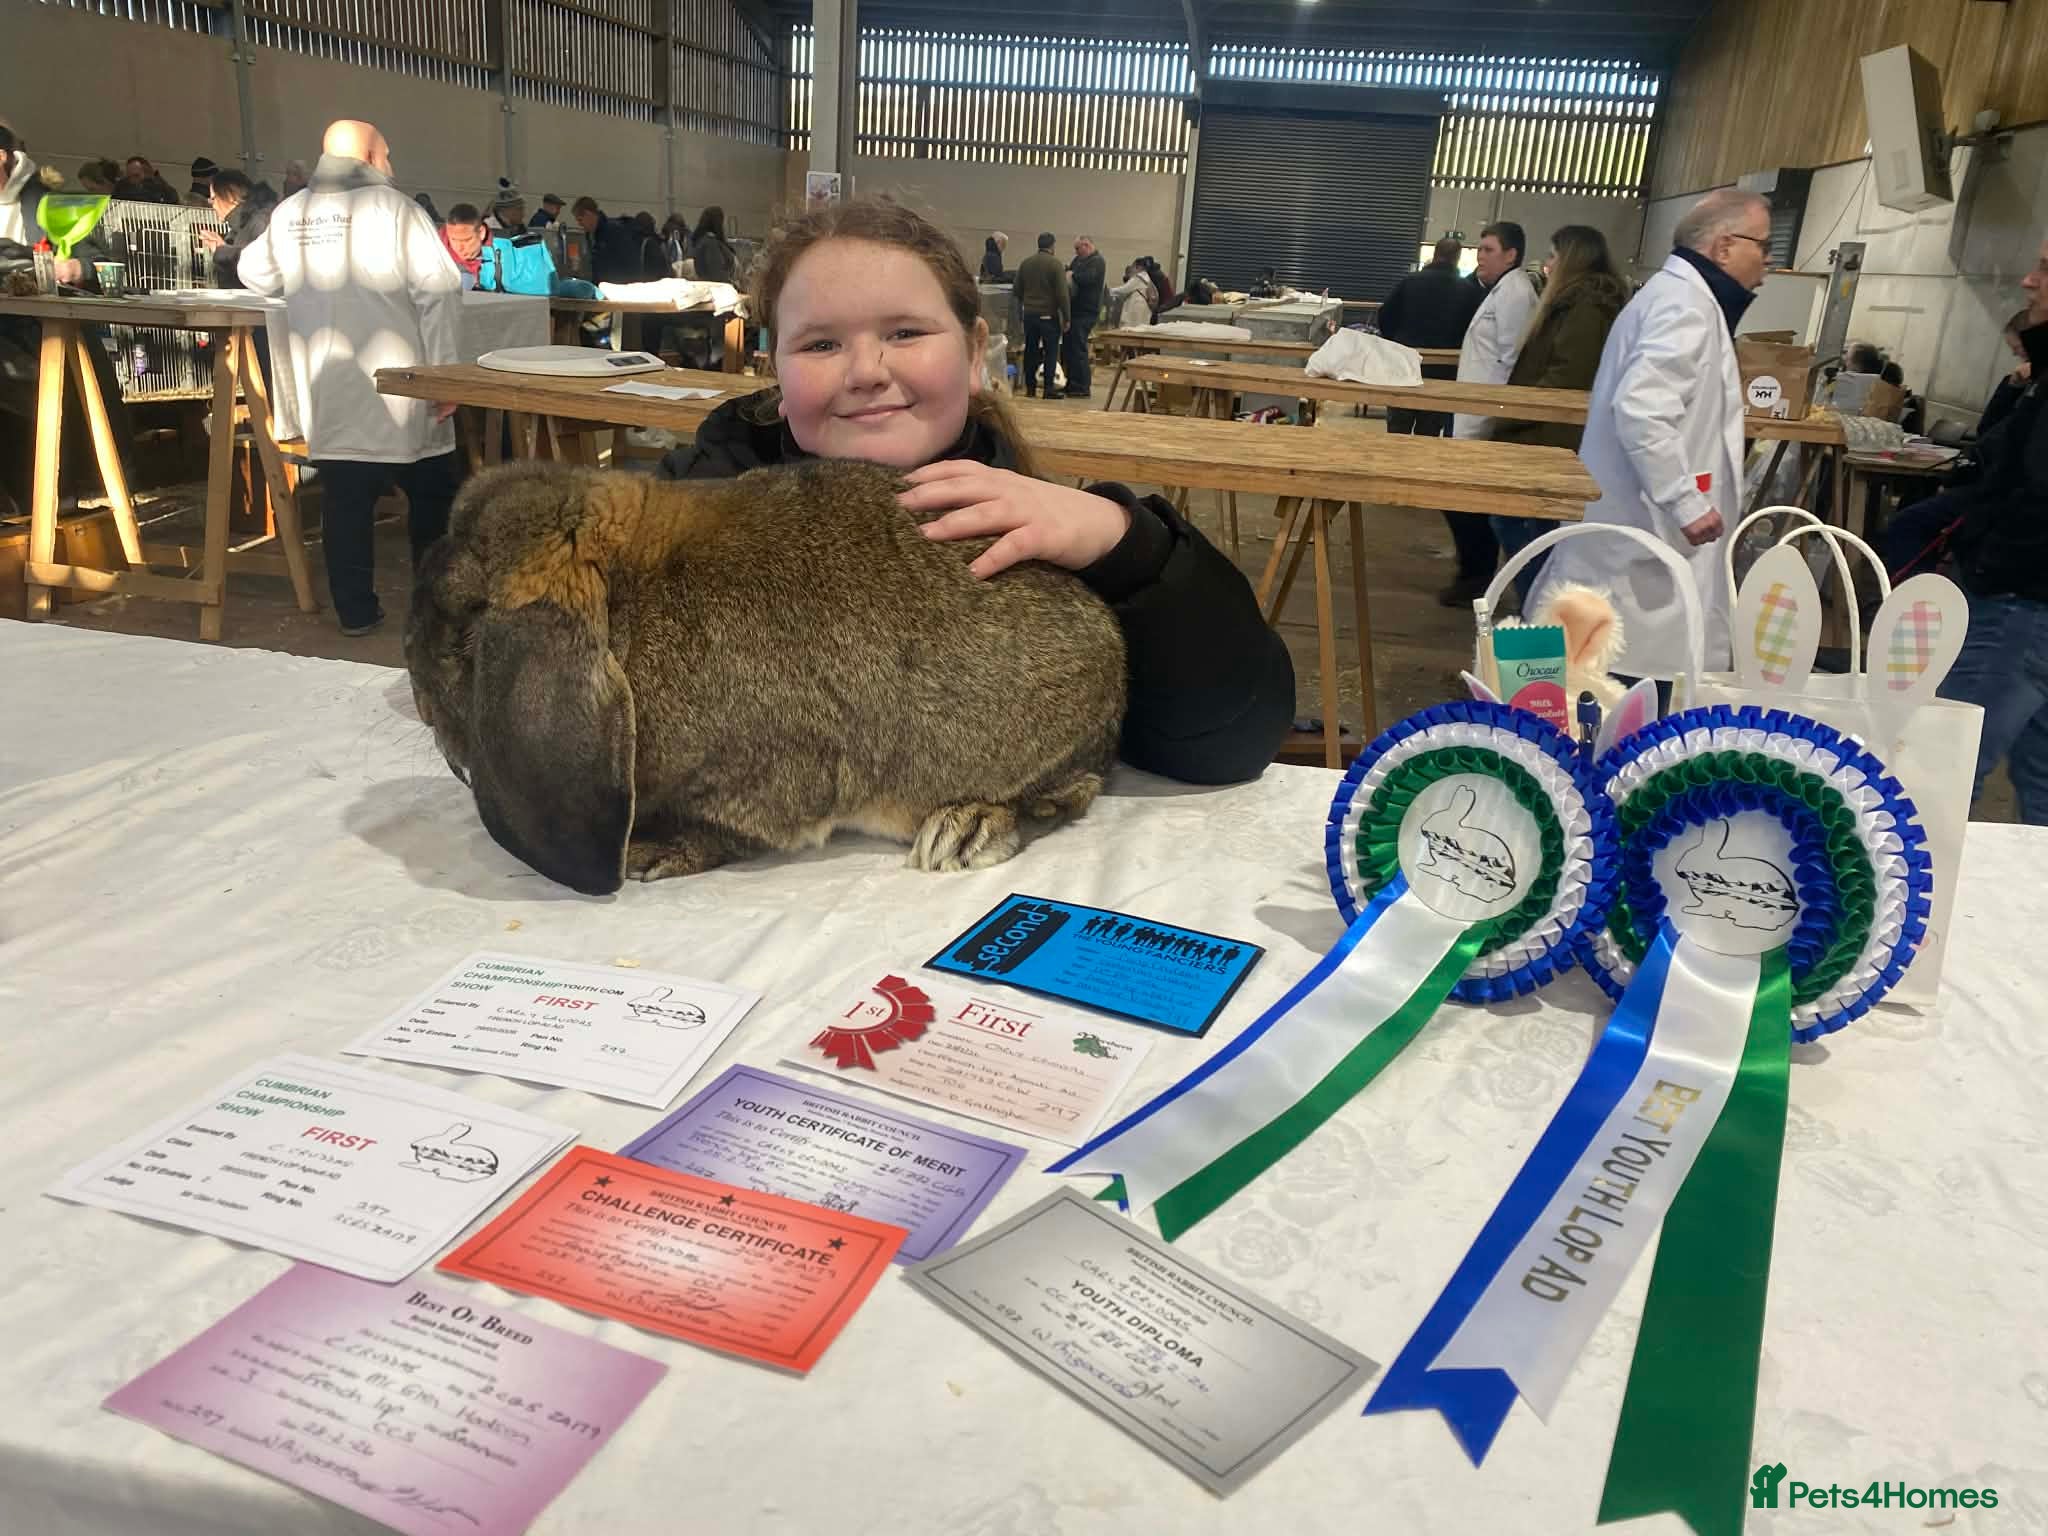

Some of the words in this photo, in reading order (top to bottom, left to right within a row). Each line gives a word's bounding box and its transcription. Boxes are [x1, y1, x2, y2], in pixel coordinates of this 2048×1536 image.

[977, 905, 1050, 970] second
[475, 962, 544, 976] CUMBRIAN
[1072, 933, 1091, 943] THE
[1095, 937, 1143, 956] YOUNG
[1144, 948, 1227, 975] FANCIERS
[450, 981, 494, 992] SHOW
[463, 971, 562, 989] CHAMPIONSHIP
[599, 988, 625, 996] COM
[533, 994, 600, 1011] FIRST
[956, 1003, 1035, 1038] First
[236, 1090, 346, 1118] CHAMPIONSHIP
[255, 1078, 333, 1099] CUMBRIAN
[217, 1101, 265, 1117] SHOW
[301, 1125, 378, 1151] FIRST
[733, 1097, 787, 1120] YOUTH
[786, 1113, 888, 1153] CERTIFICATE
[888, 1146, 913, 1160] OF
[912, 1154, 968, 1178] MERIT
[769, 1127, 810, 1146] Certify
[1581, 1132, 1673, 1213] YOUTH
[581, 1189, 702, 1230] CHALLENGE
[702, 1222, 834, 1267] CERTIFICATE
[1552, 1205, 1625, 1265] LOP
[1520, 1253, 1588, 1304] AD
[1071, 1279, 1128, 1318] YOUTH
[1126, 1315, 1204, 1369] DIPLOMA
